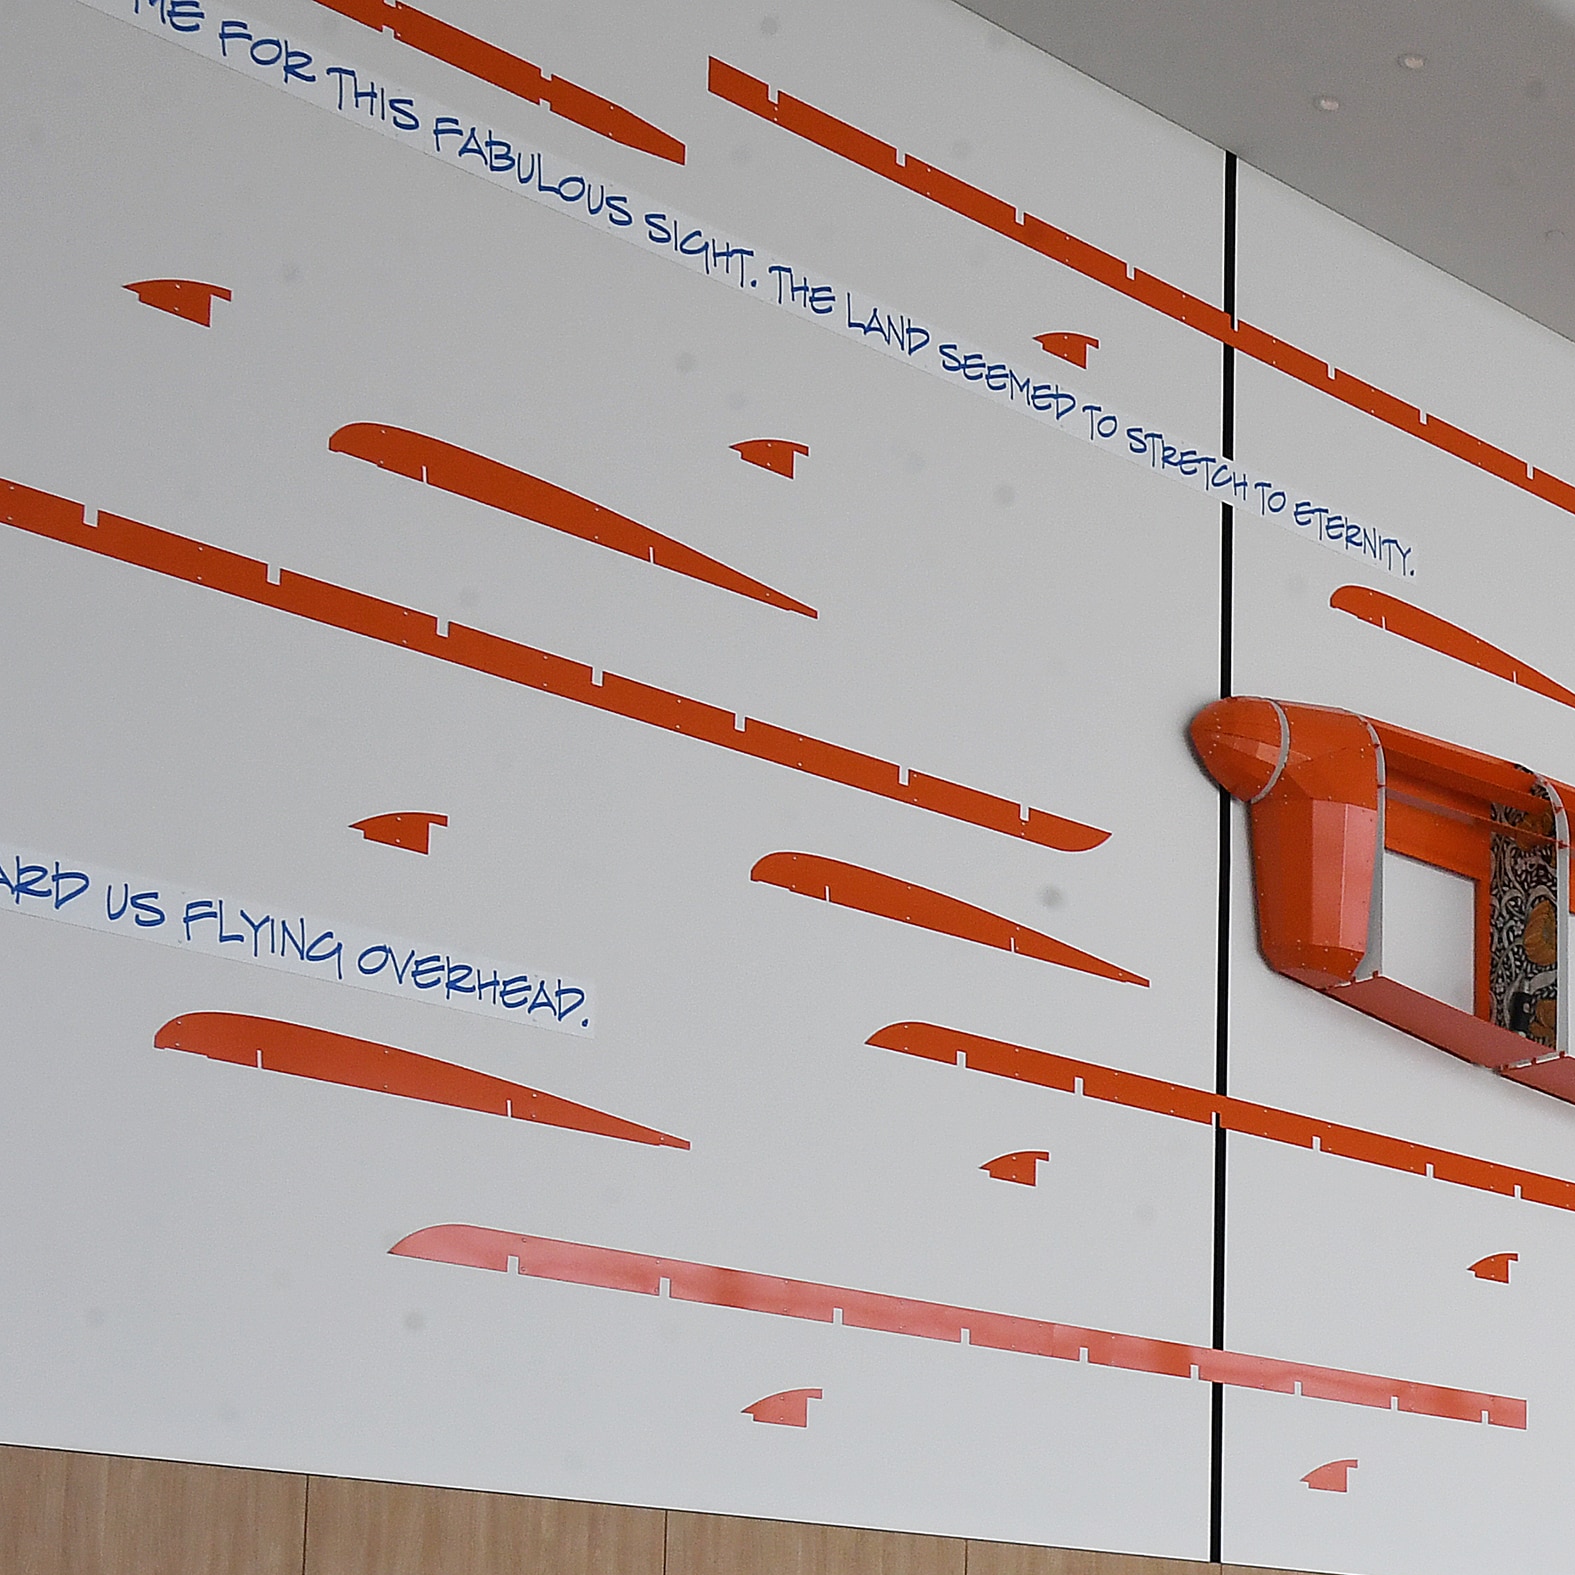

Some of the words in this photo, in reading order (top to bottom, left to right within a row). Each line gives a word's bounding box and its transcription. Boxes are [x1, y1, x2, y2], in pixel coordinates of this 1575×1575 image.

[218, 19, 317, 83] FOR
[326, 65, 420, 131] THIS
[433, 116, 633, 227] FABULOUS
[644, 212, 758, 288] SIGHT.
[768, 264, 836, 315] THE
[846, 292, 930, 356] LAND
[938, 342, 1077, 421] SEEMED
[1081, 403, 1118, 440] TO
[1126, 426, 1249, 500] STRETCH
[1254, 480, 1288, 516] TO
[1293, 500, 1415, 576] ETERNITY.
[106, 883, 166, 928] US
[182, 898, 343, 981] FLYING
[356, 943, 590, 1028] OVERHEAD.
